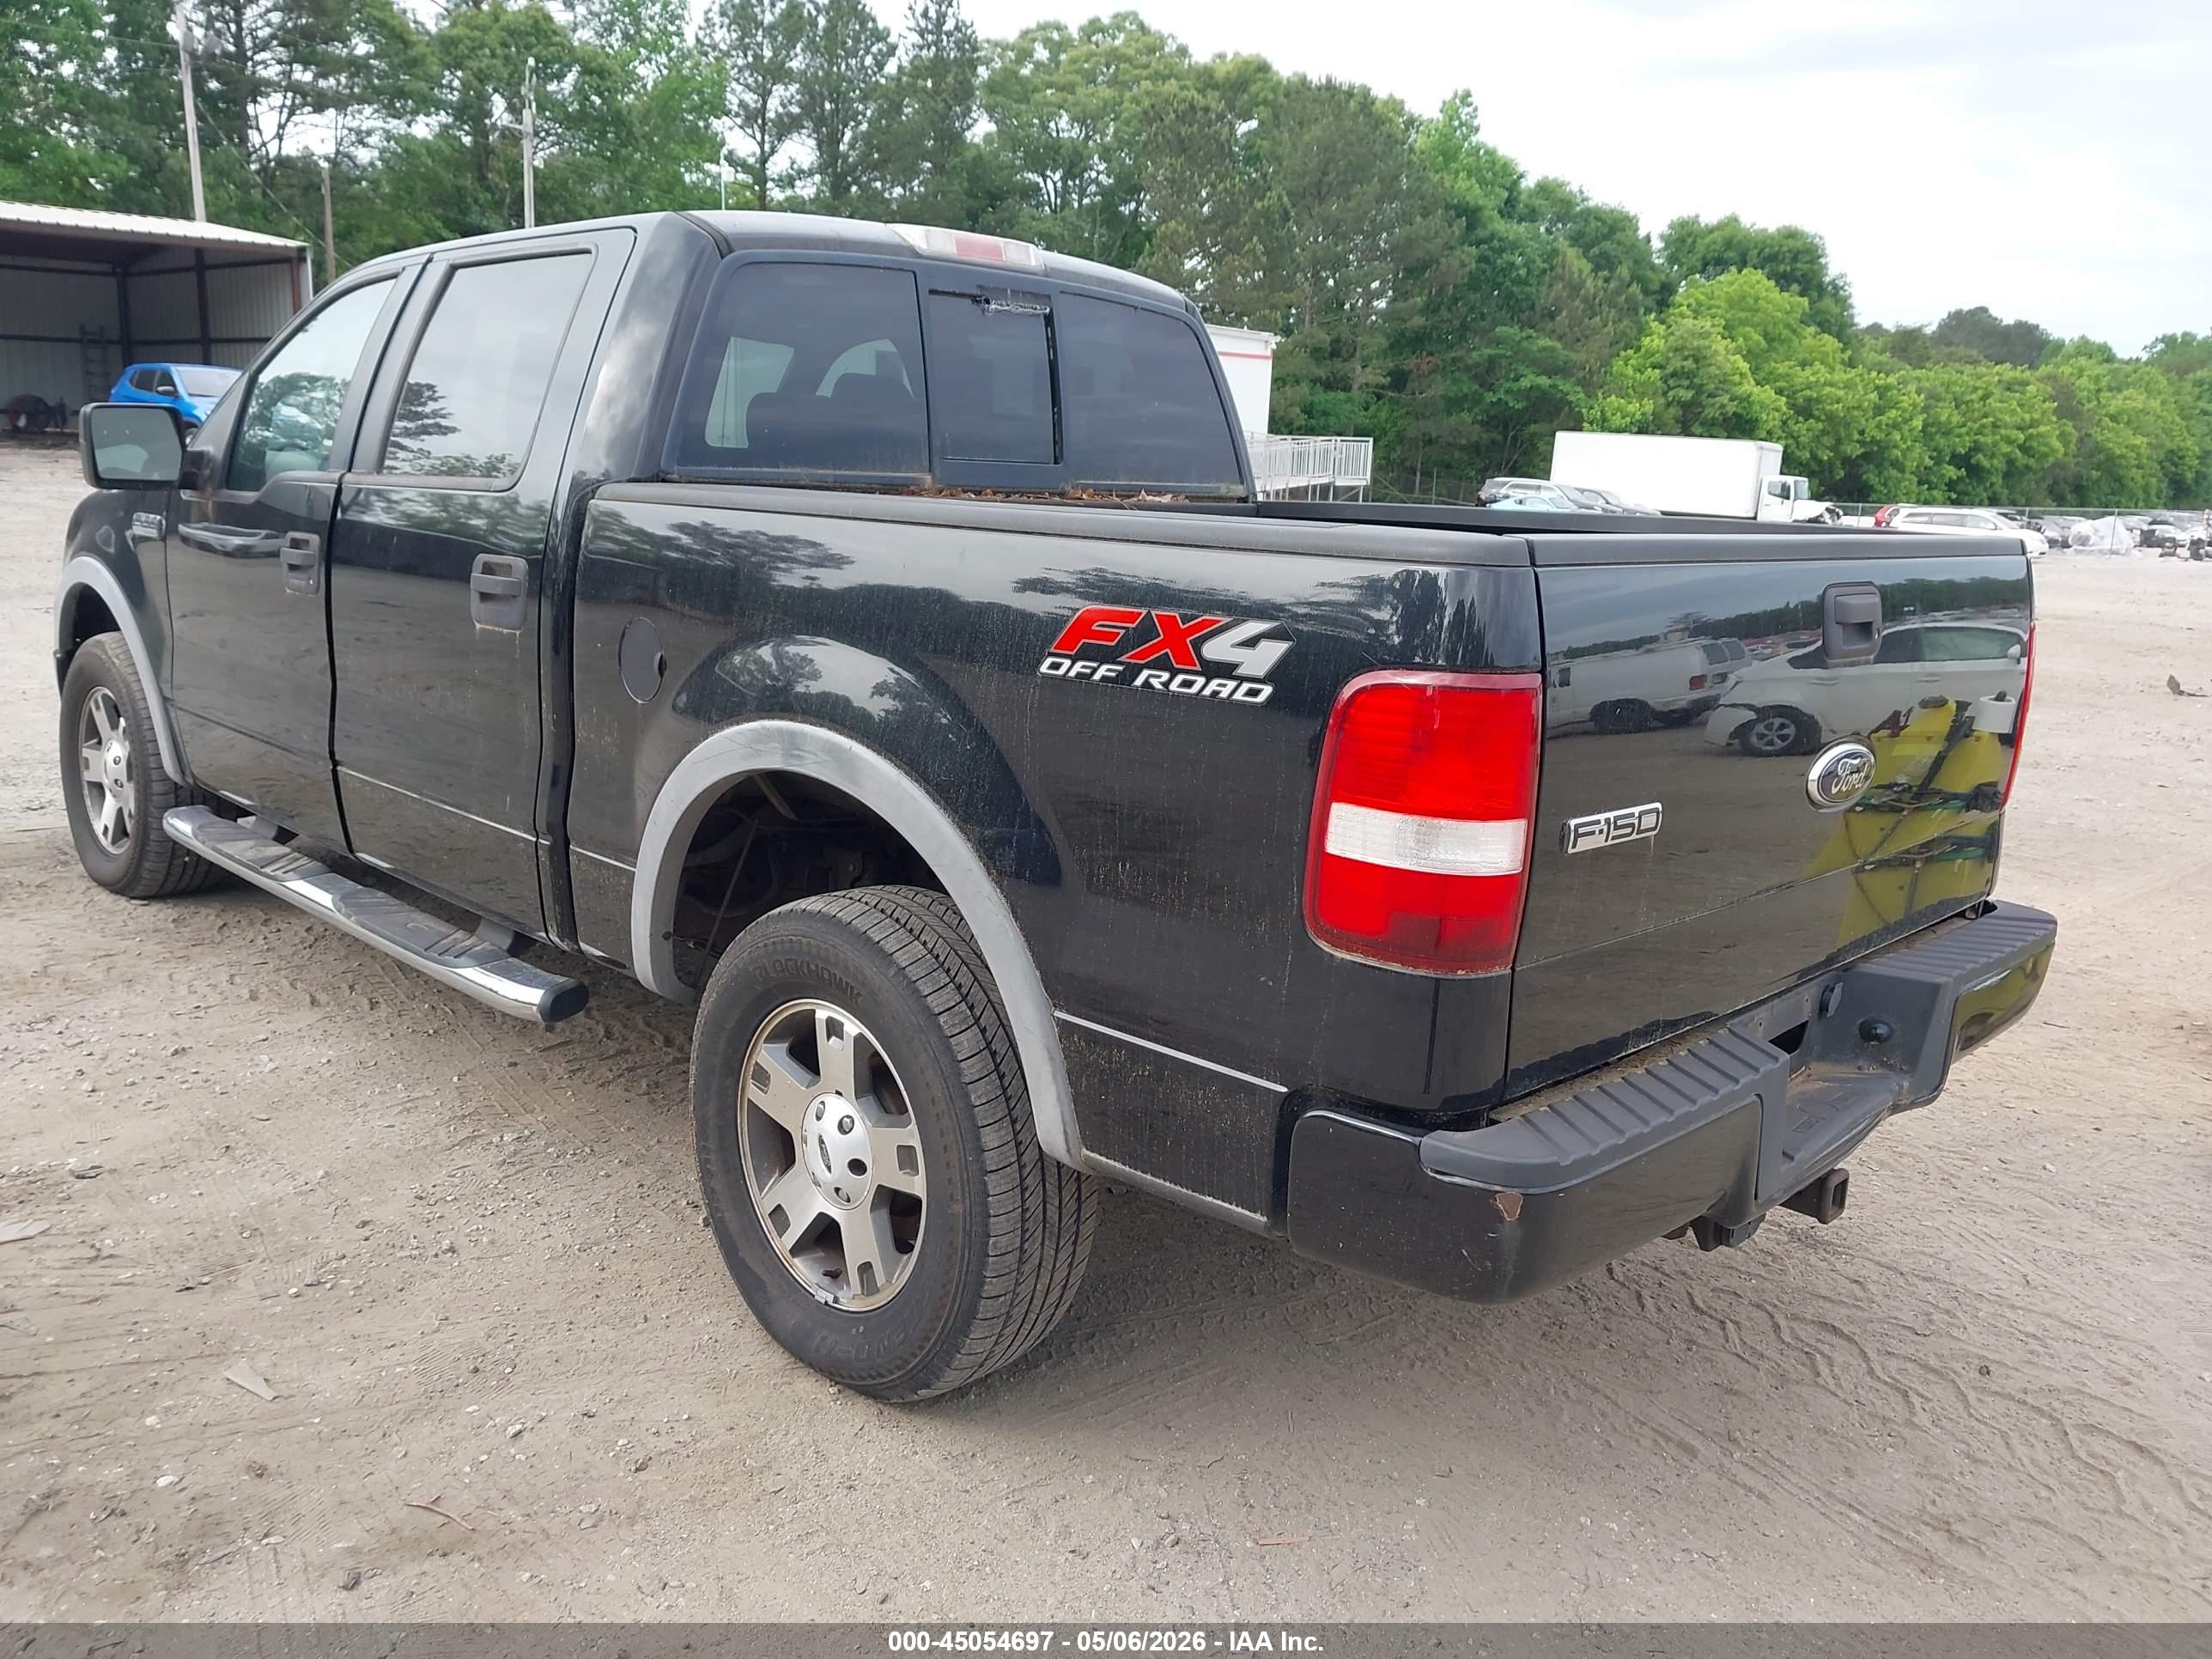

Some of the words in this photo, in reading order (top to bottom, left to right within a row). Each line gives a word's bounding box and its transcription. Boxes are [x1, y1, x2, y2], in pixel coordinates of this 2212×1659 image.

[1048, 605, 1293, 678] FX4
[1038, 656, 1126, 681] OFF
[1130, 668, 1275, 704] ROAD
[1831, 757, 1871, 794] Ford
